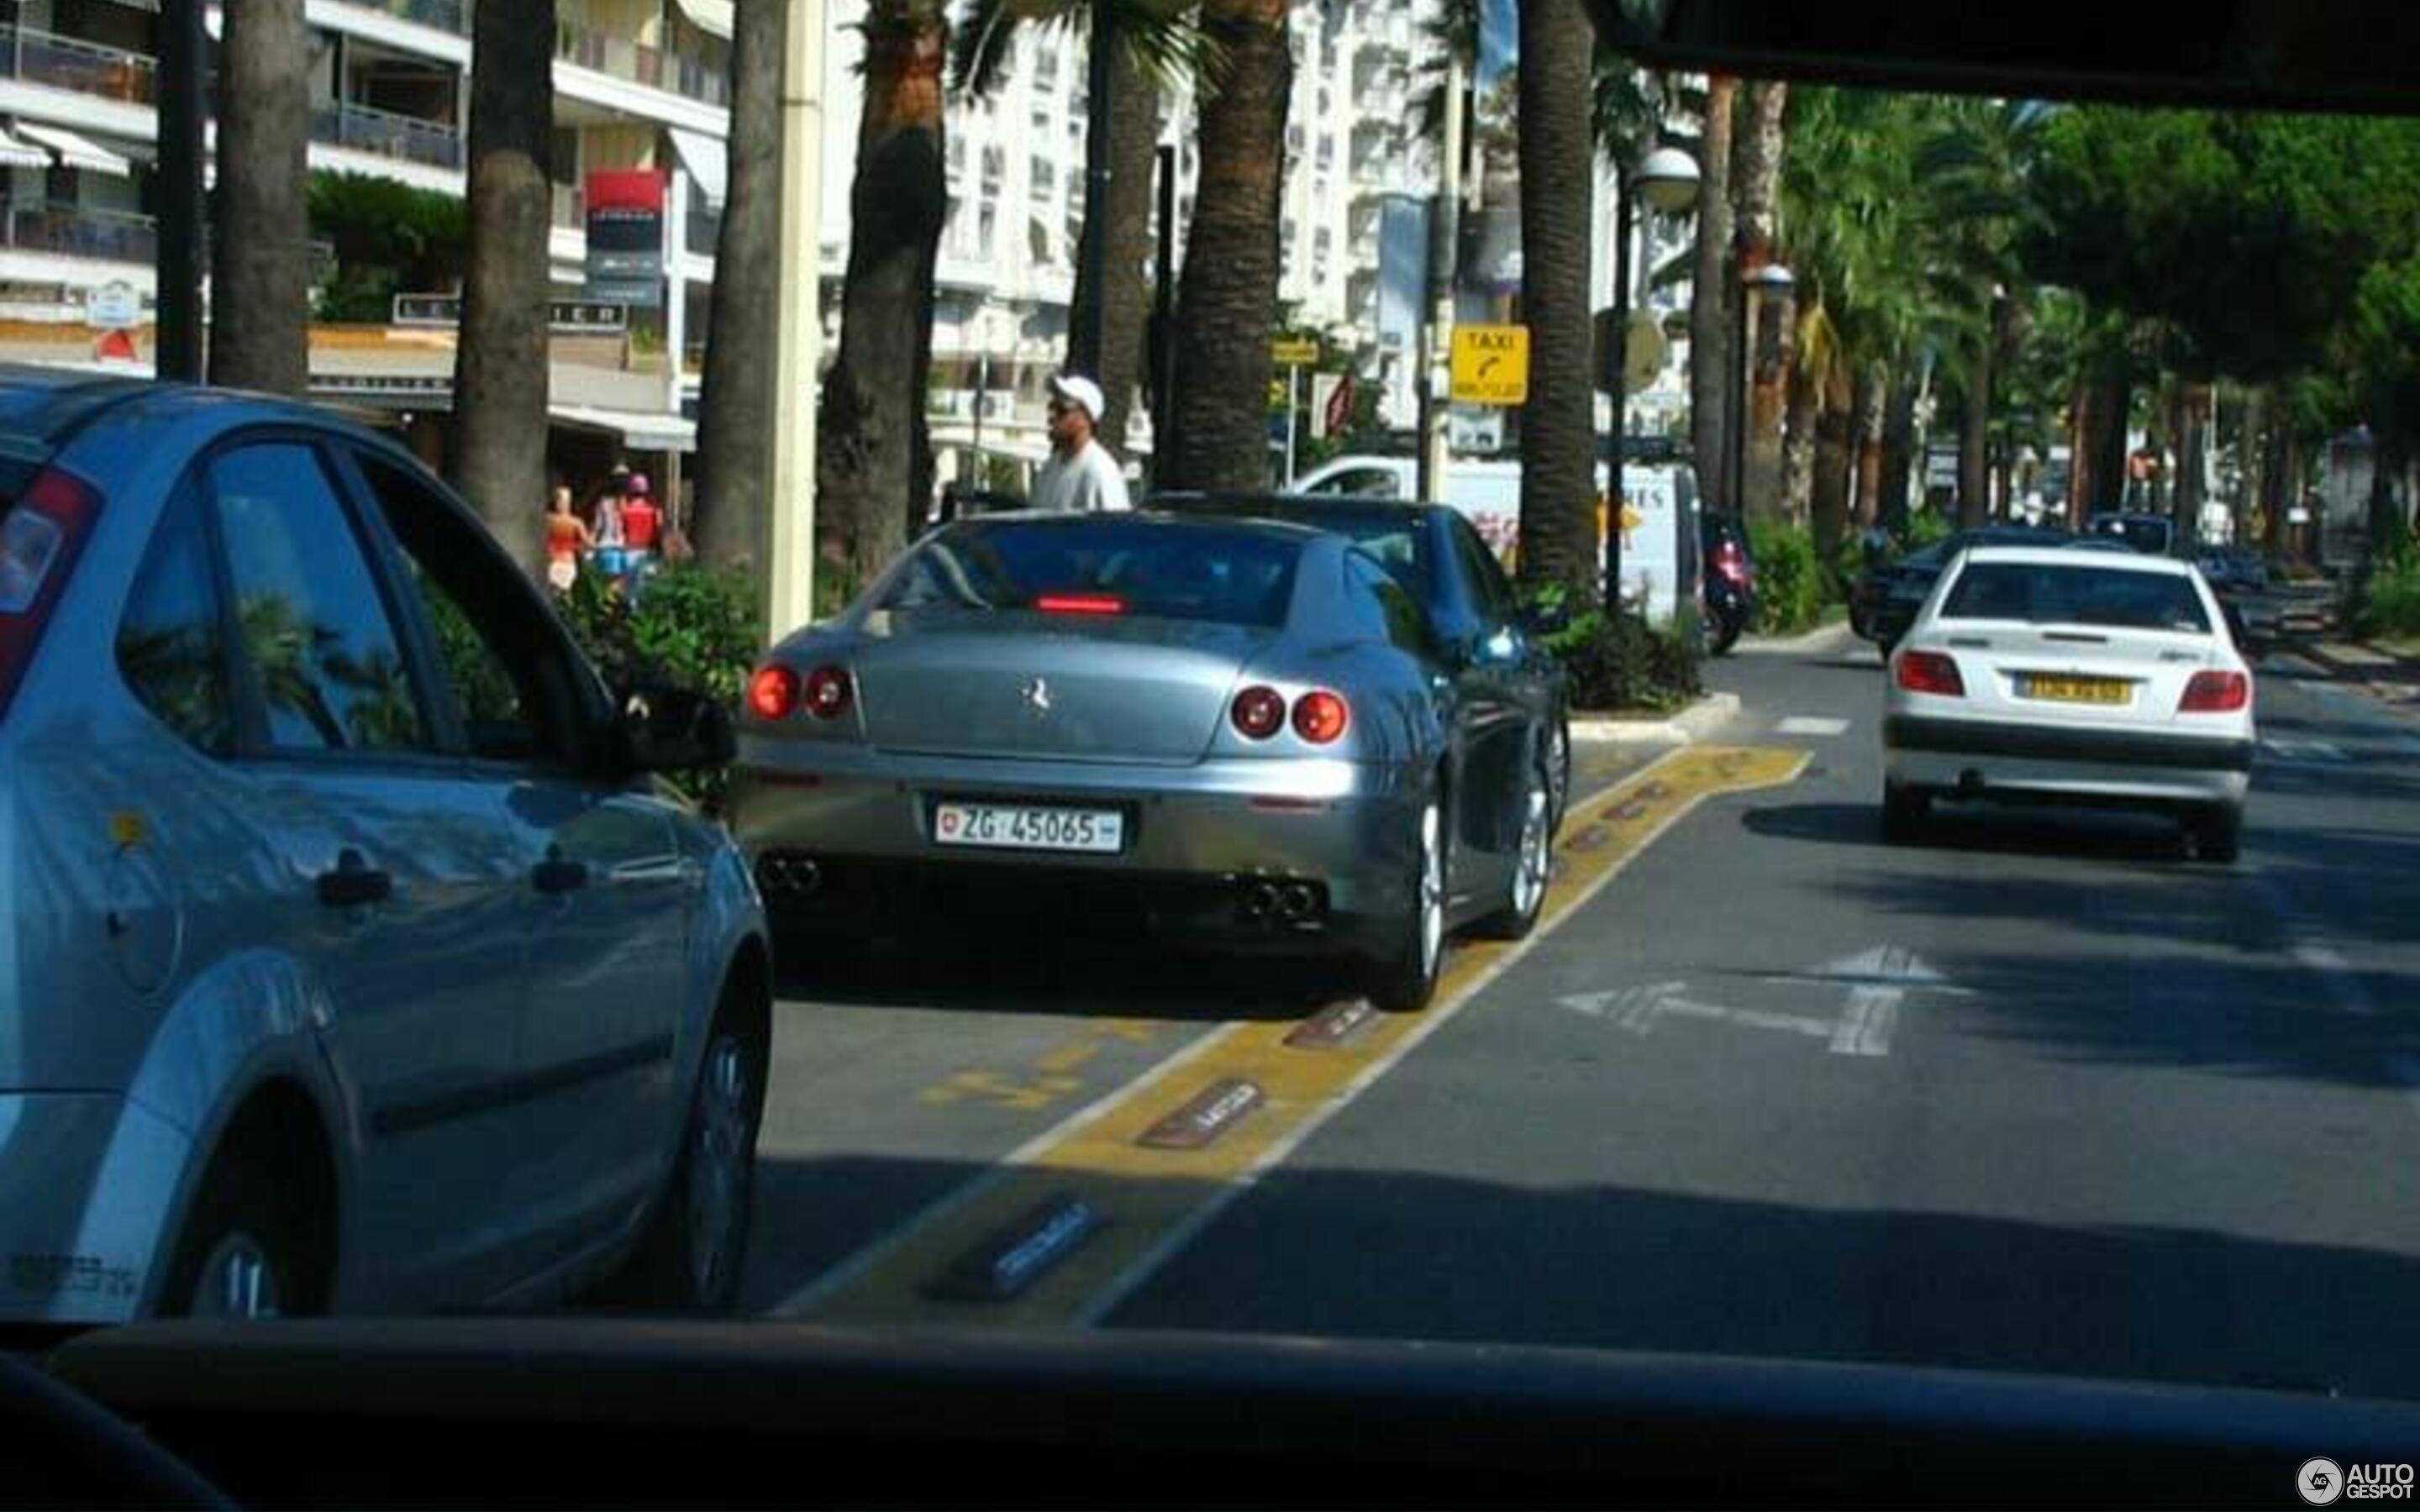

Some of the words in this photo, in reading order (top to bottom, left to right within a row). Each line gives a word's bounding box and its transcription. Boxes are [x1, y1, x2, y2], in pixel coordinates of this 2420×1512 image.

[1468, 332, 1514, 349] TAXI
[963, 809, 995, 838] ZG
[1011, 810, 1094, 843] 45065
